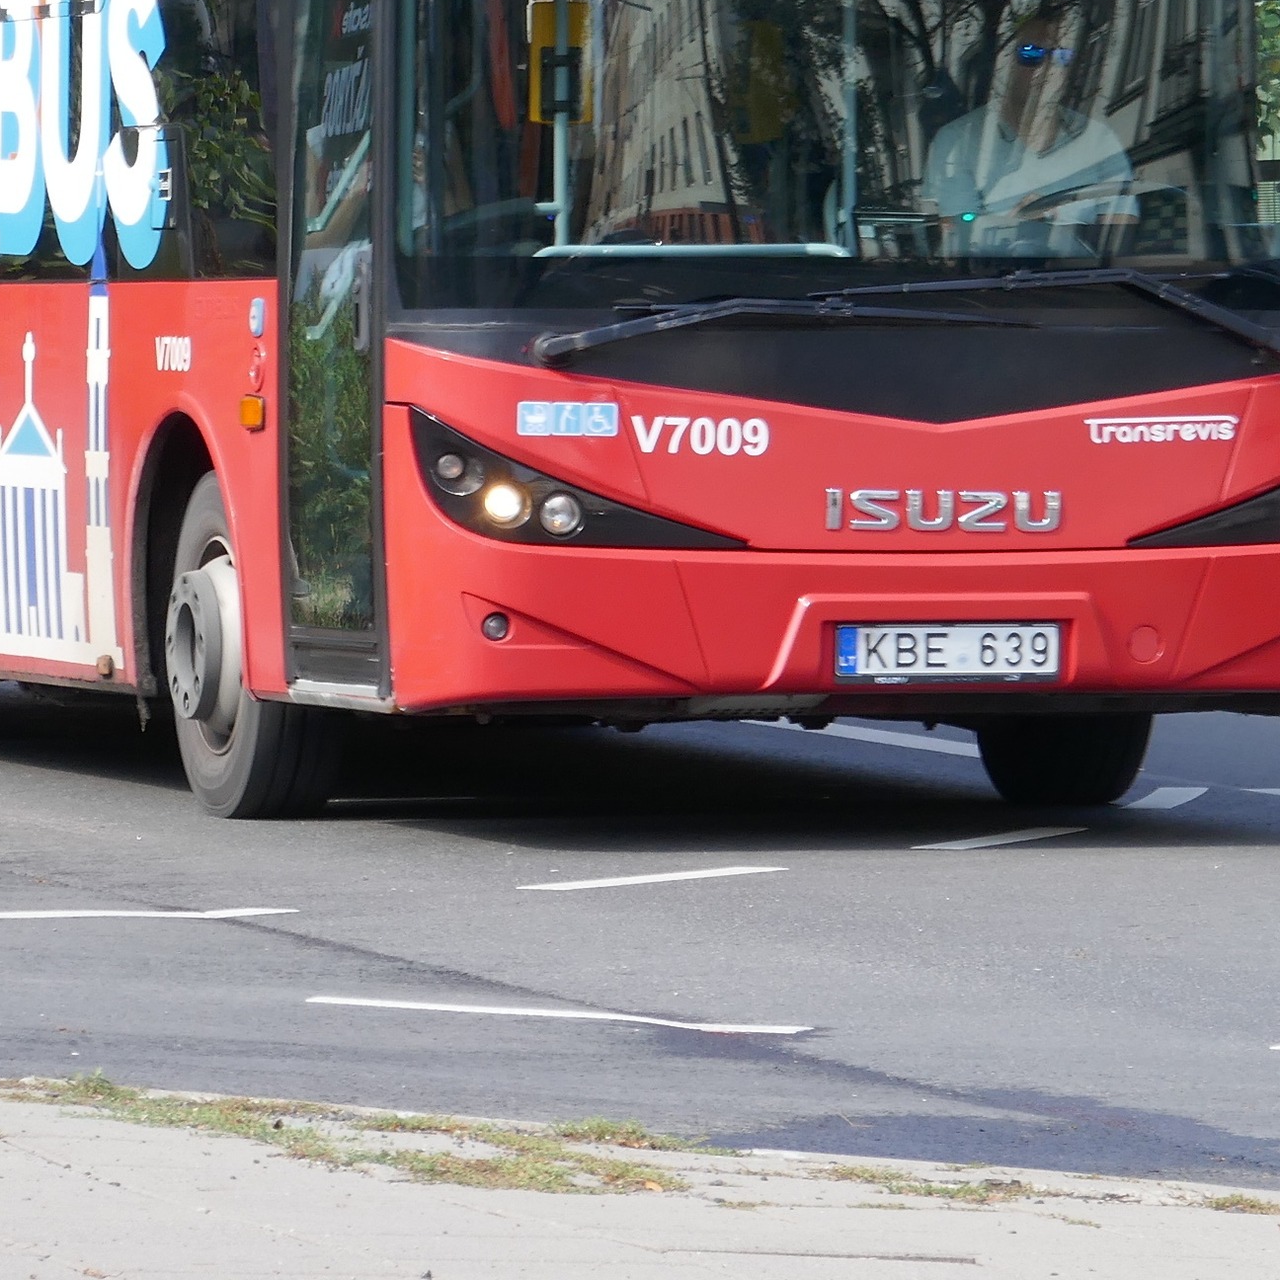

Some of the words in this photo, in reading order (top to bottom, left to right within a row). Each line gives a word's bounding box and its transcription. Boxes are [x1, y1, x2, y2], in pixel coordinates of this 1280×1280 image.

[631, 415, 769, 457] V7009
[1083, 415, 1239, 444] Transrevis
[825, 488, 1062, 533] ISUZU
[864, 632, 949, 669] KBE
[979, 631, 1049, 667] 639
